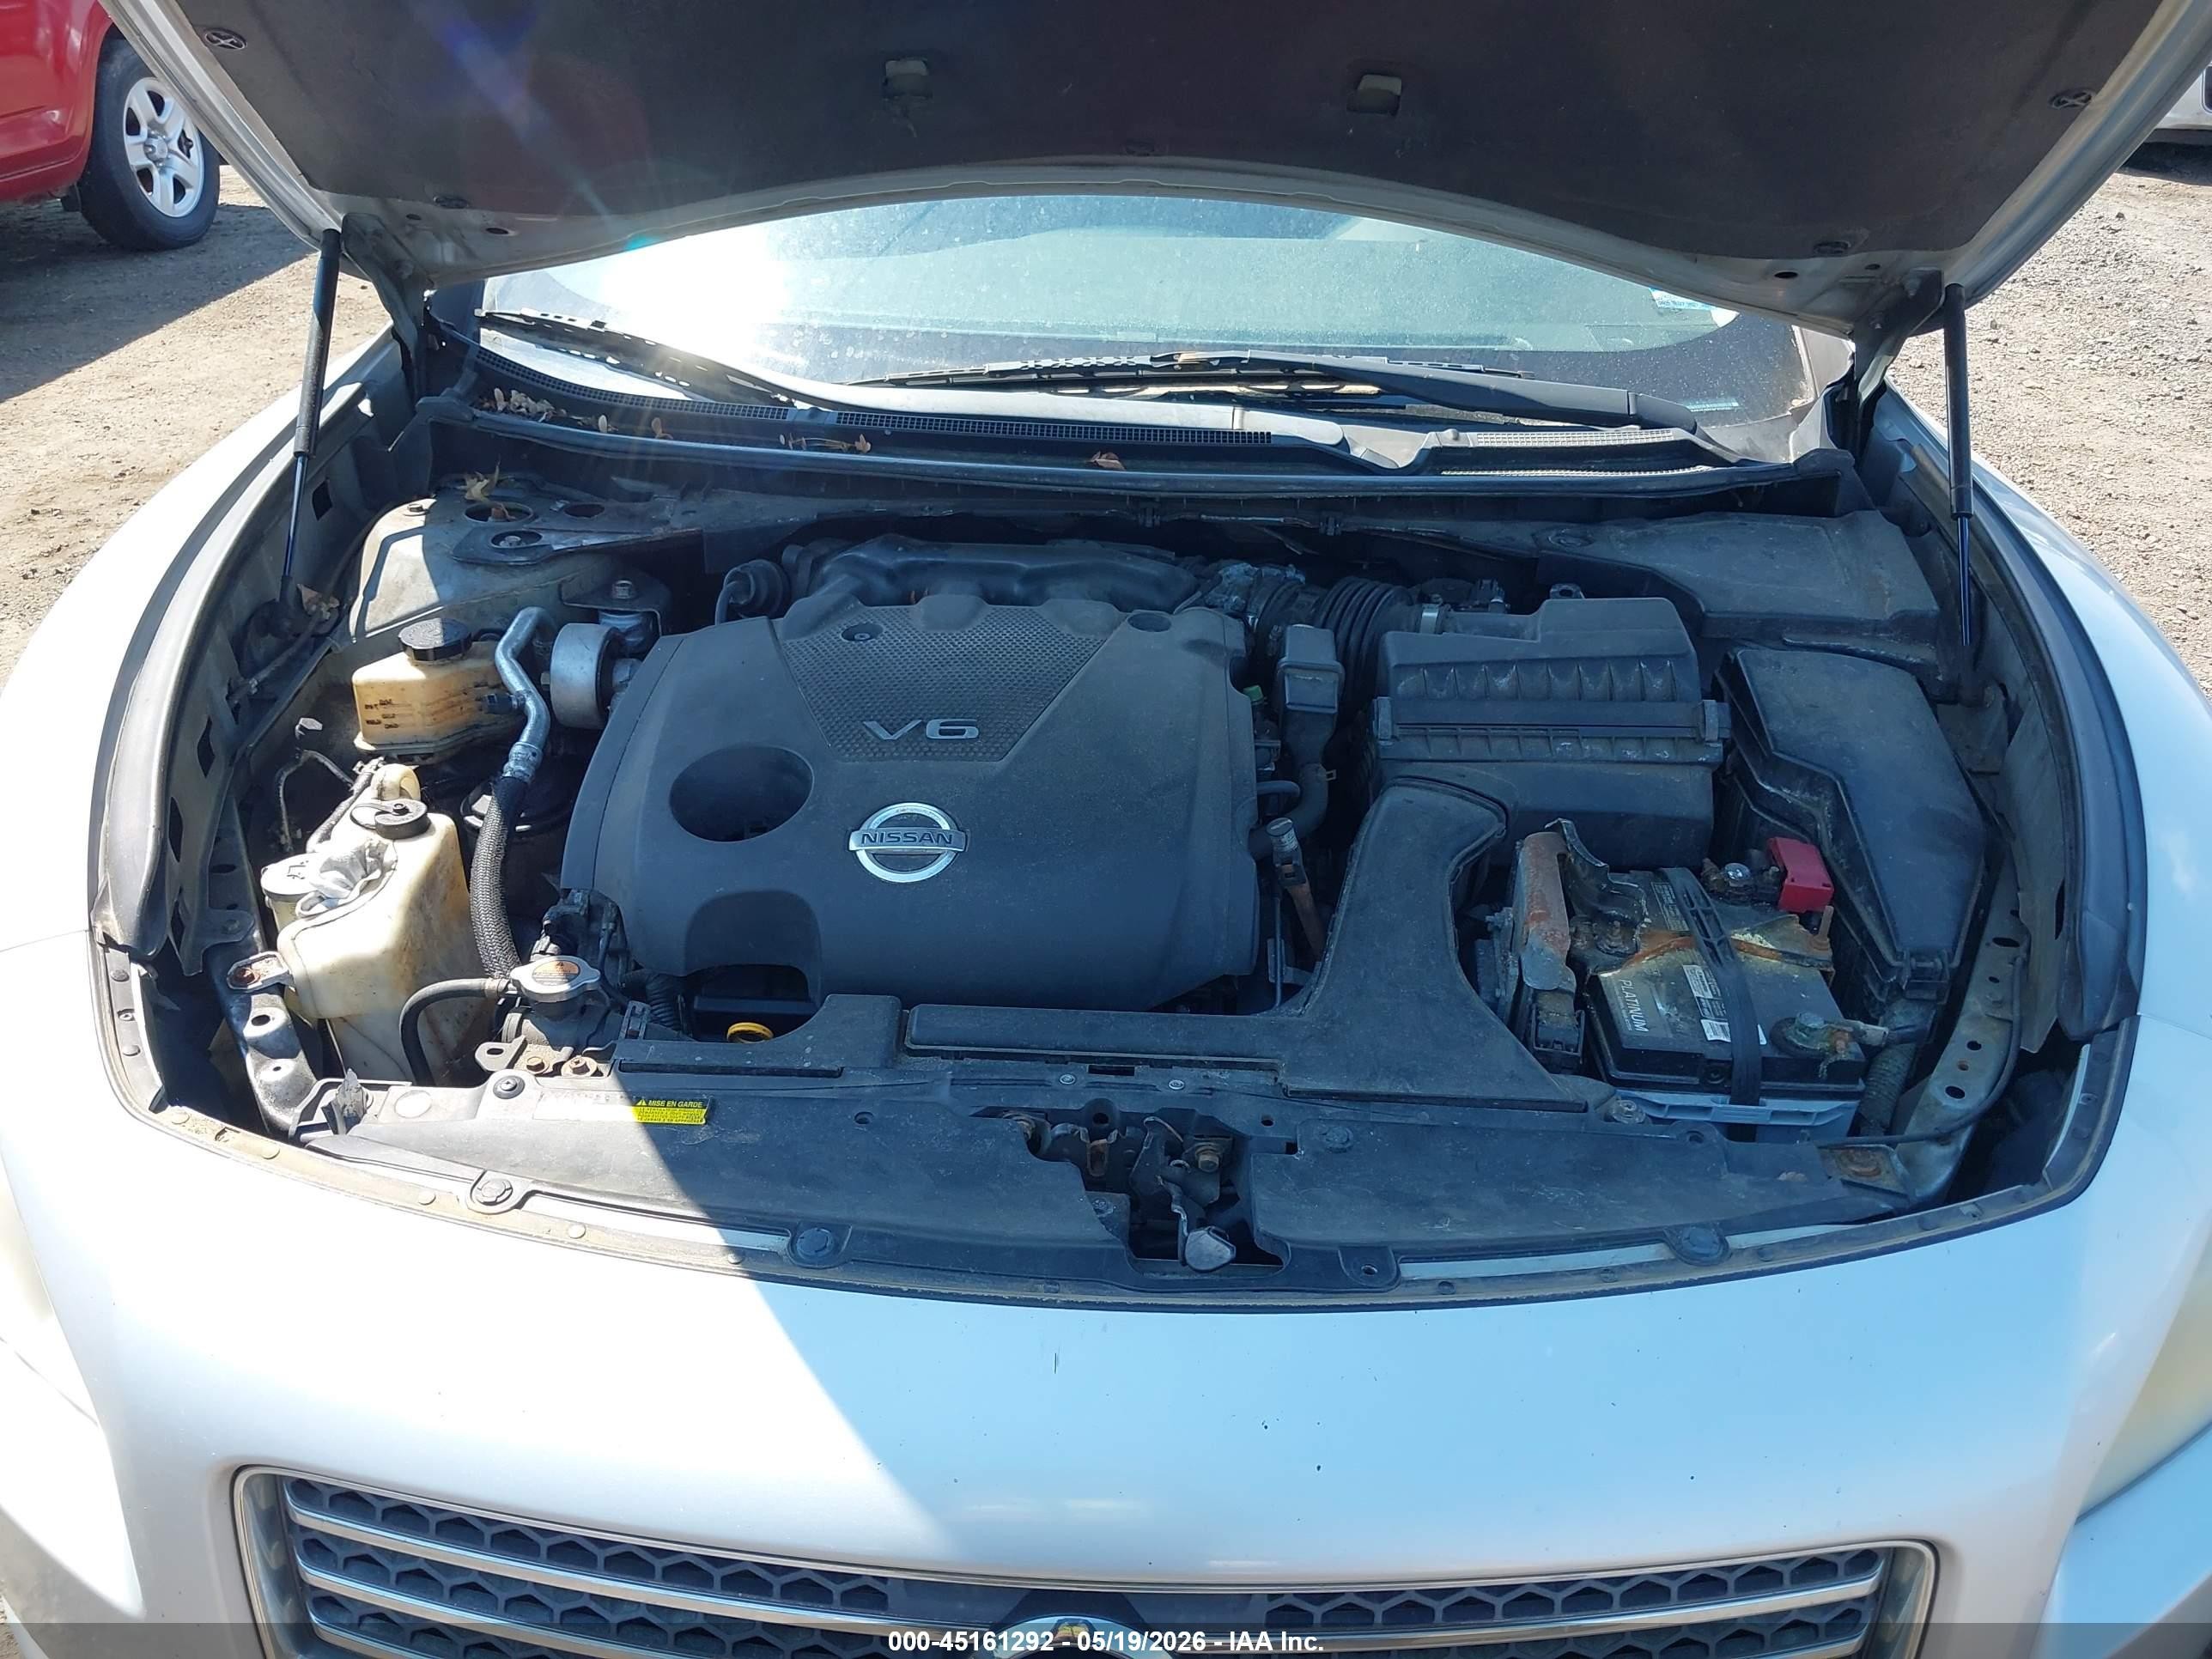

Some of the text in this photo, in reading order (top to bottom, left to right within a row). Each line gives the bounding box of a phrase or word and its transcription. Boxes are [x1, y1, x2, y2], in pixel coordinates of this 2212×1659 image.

[862, 718, 980, 740] V6
[860, 832, 953, 845] NISSAN
[1620, 979, 1650, 1032] PLATINUM
